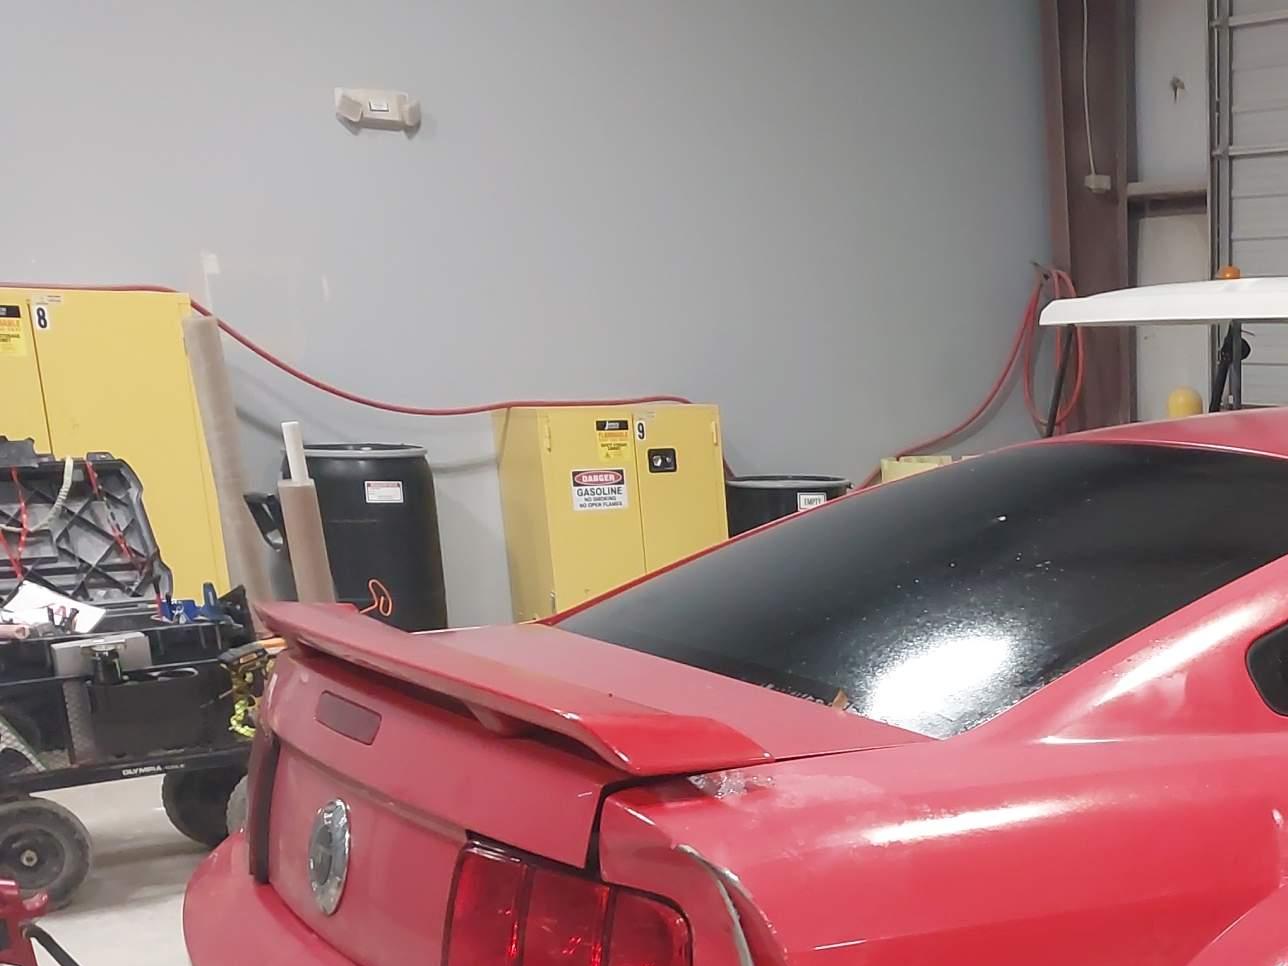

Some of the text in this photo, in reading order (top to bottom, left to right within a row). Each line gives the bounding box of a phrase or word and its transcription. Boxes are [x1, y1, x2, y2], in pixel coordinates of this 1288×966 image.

[36, 306, 48, 329] 8
[637, 422, 646, 440] 9
[581, 474, 615, 483] DANGER
[576, 486, 623, 497] GASOLINE
